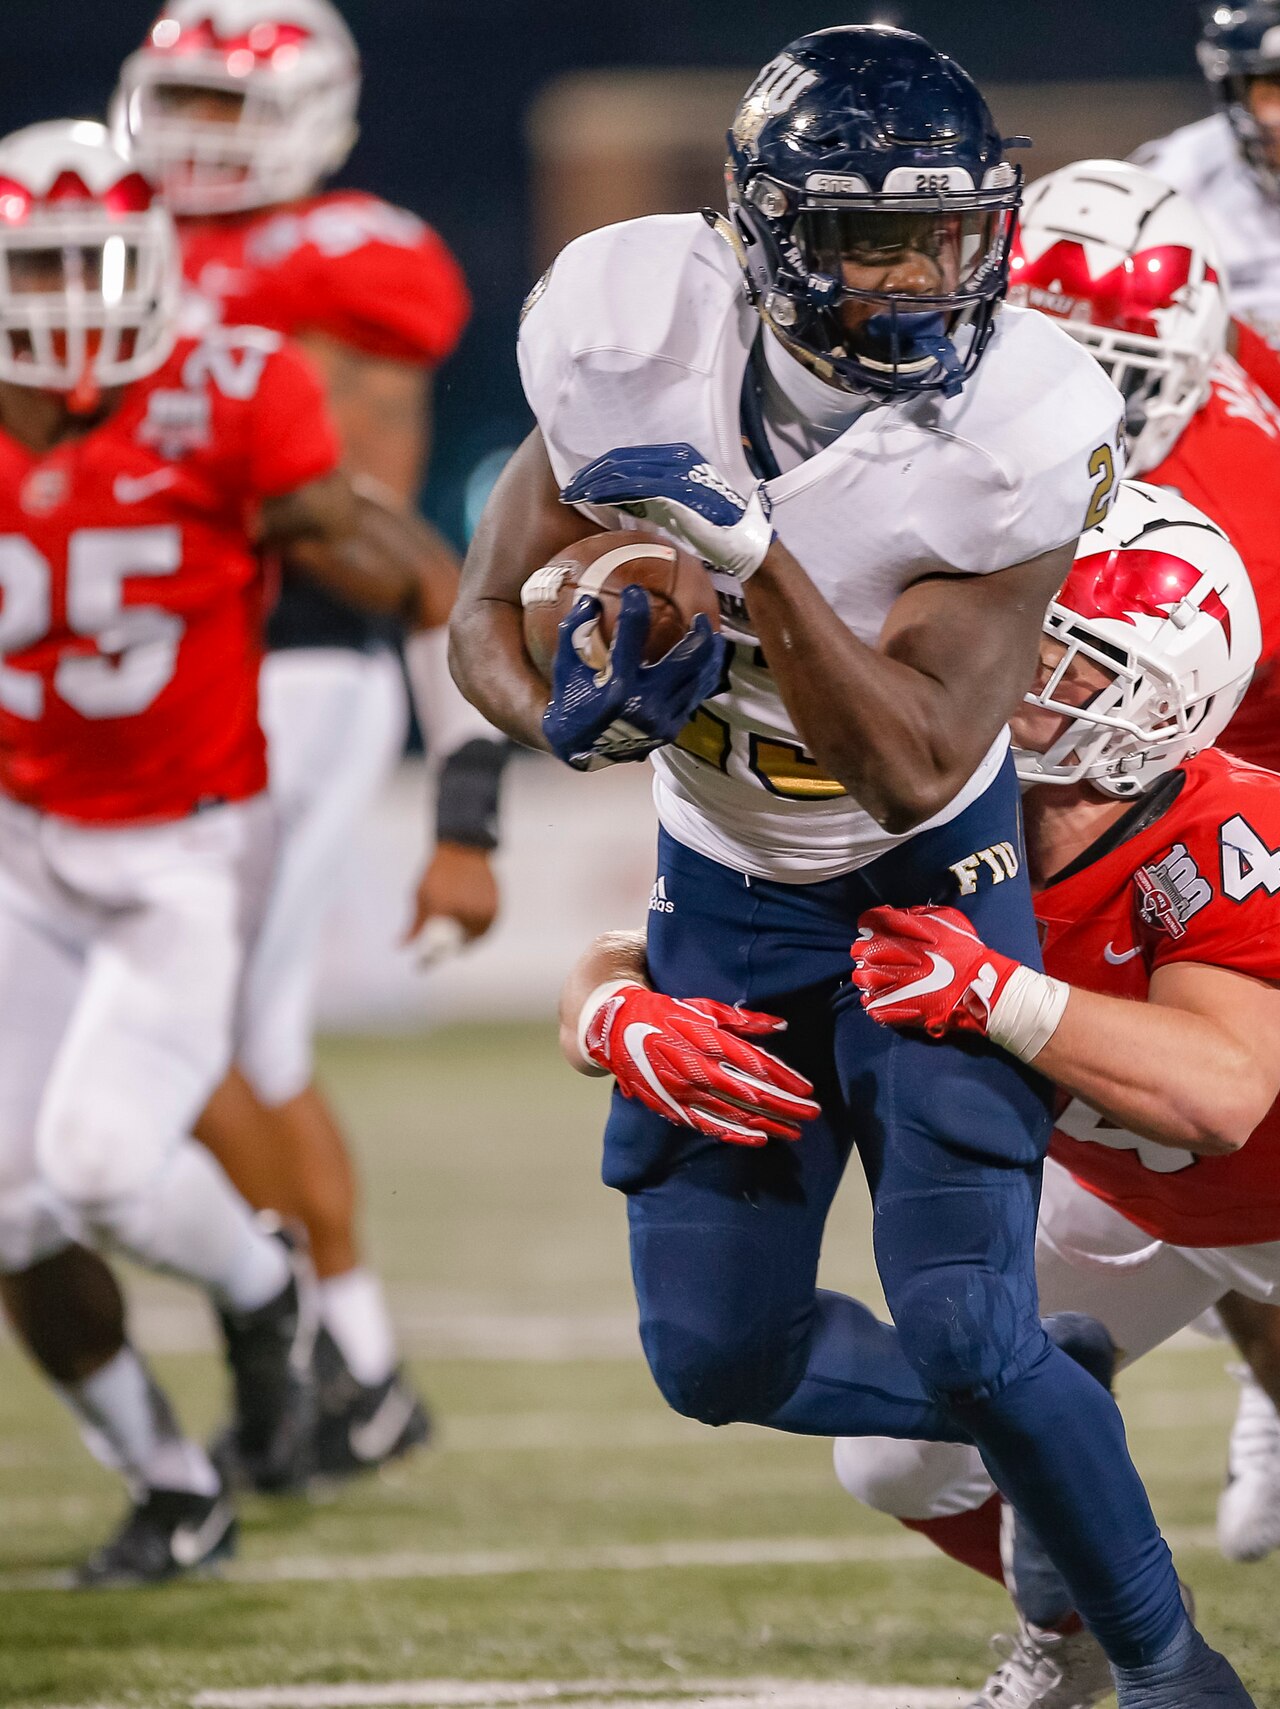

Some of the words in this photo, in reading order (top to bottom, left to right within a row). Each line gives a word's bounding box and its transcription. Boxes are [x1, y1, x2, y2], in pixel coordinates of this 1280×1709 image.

[916, 174, 950, 193] 262
[1082, 418, 1125, 532] 2
[946, 841, 1019, 897] FIU
